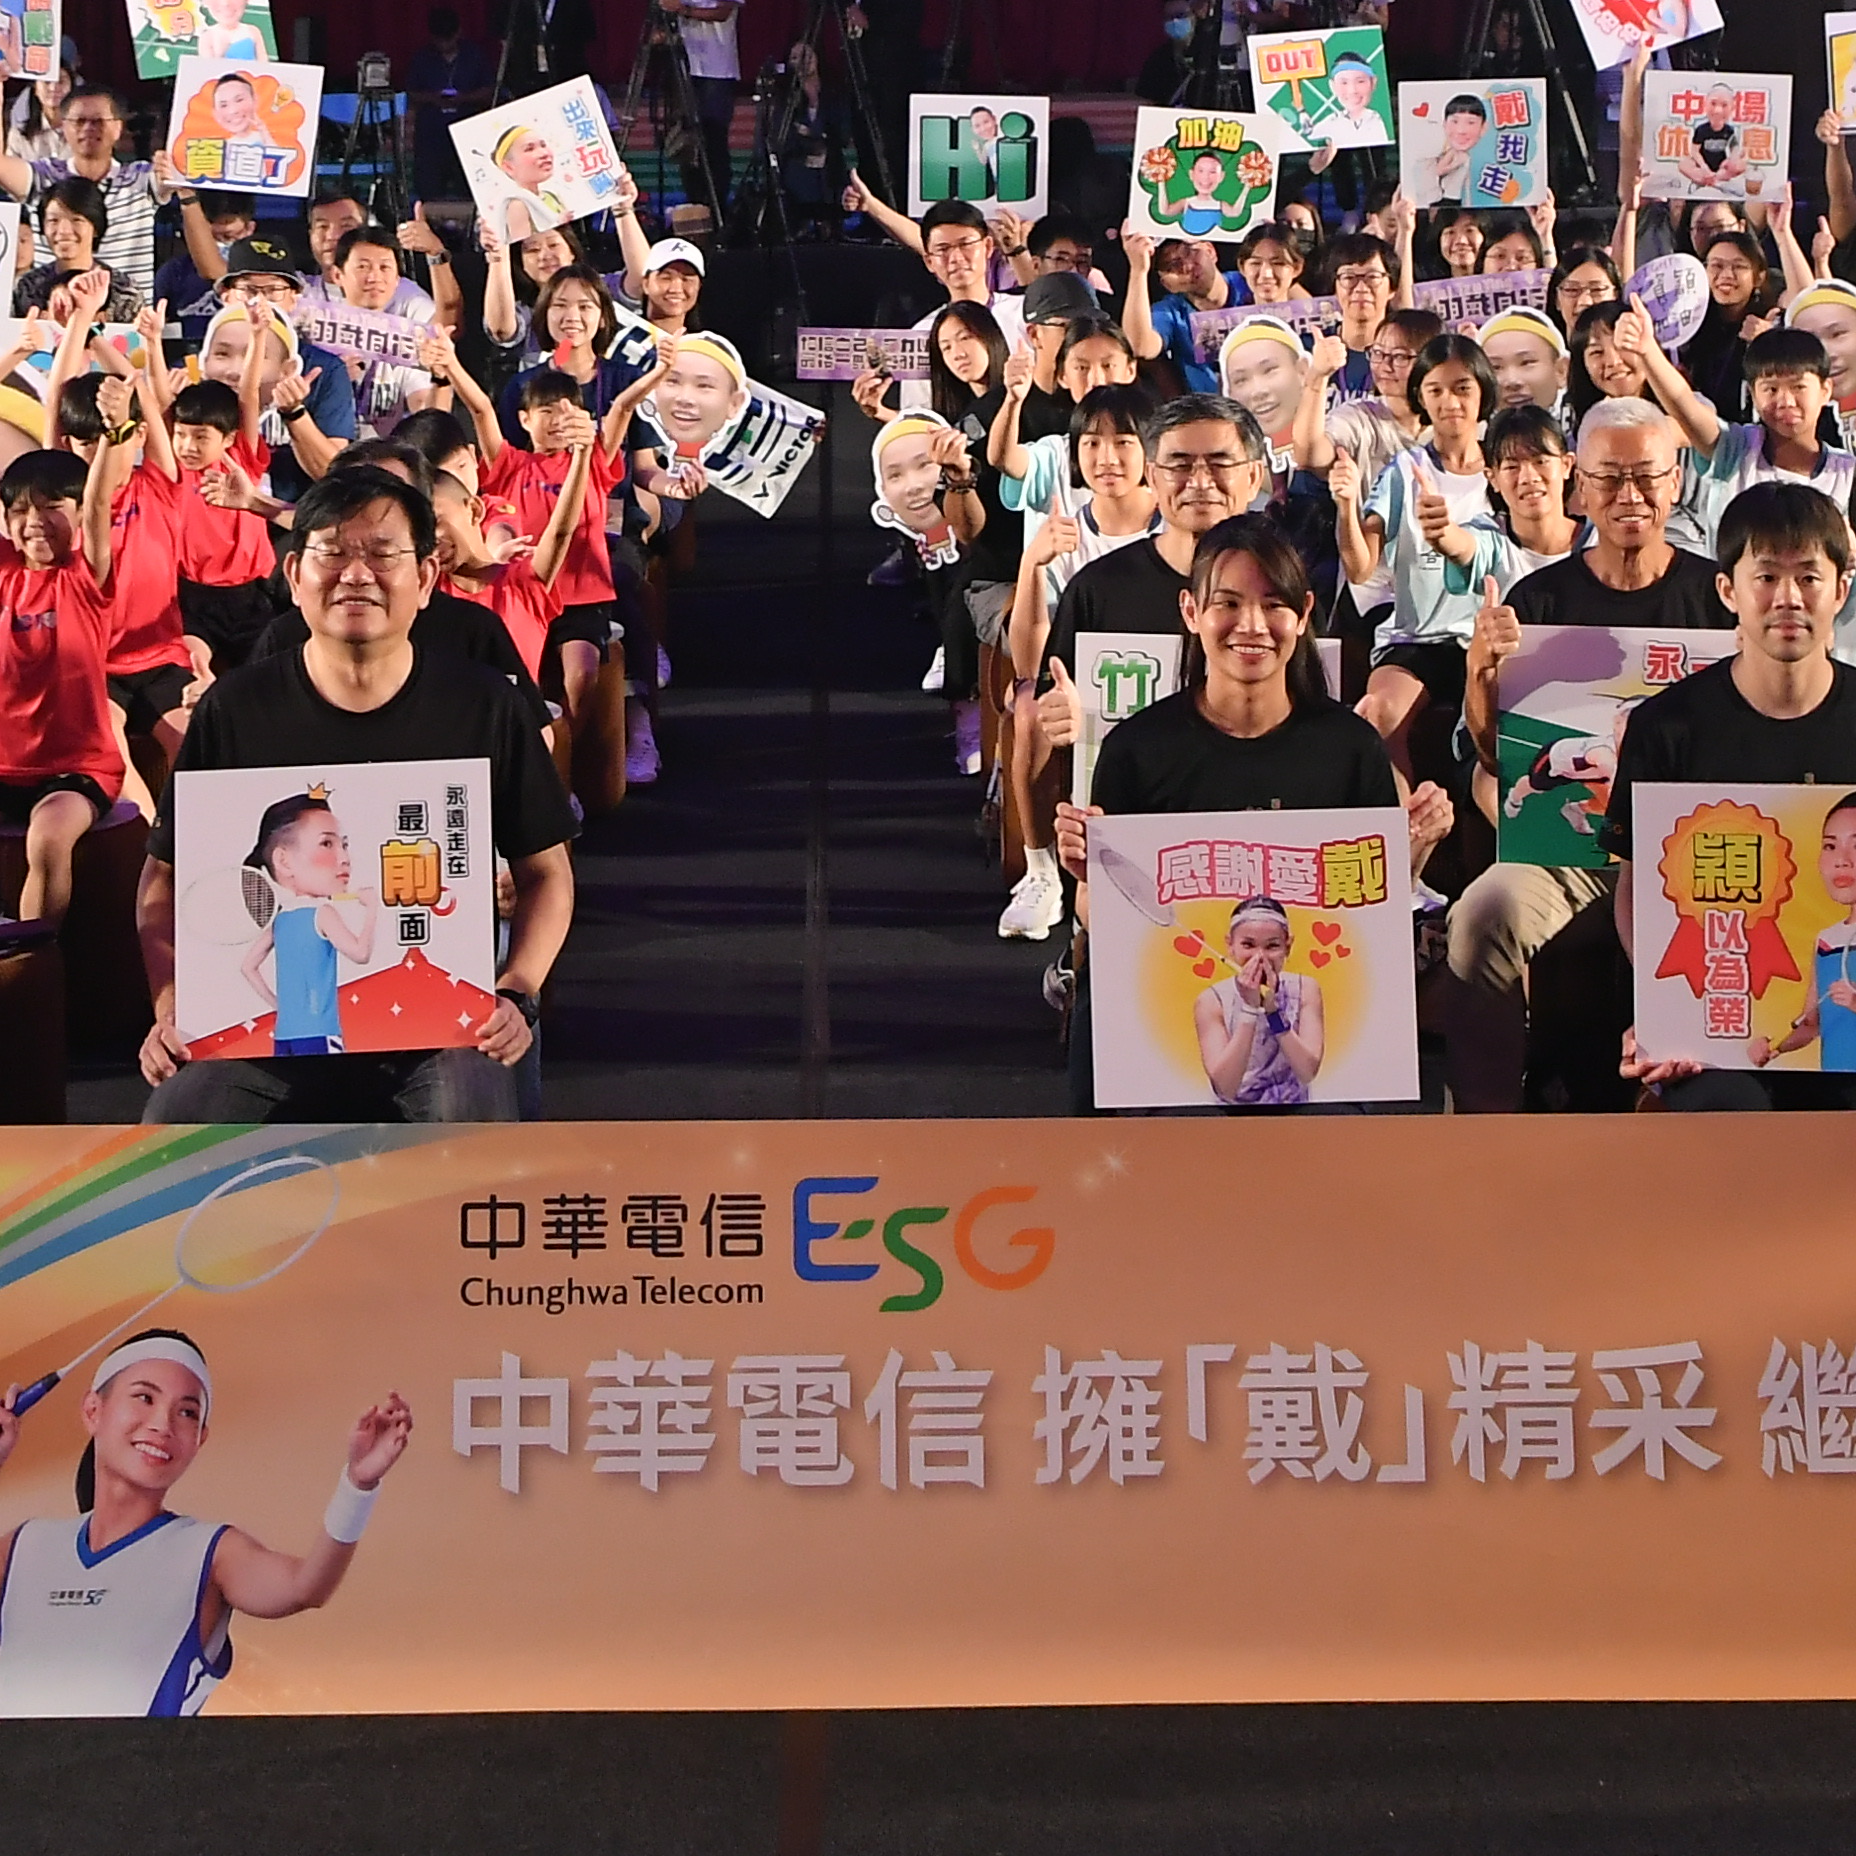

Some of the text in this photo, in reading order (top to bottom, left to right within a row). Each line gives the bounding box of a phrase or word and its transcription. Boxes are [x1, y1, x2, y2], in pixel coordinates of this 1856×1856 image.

[1265, 48, 1318, 74] OUT
[186, 137, 298, 186] 資道了
[919, 112, 1038, 202] Hi
[1178, 117, 1245, 153] 加油
[1478, 89, 1529, 199] 戴我走
[773, 415, 819, 479] VICTOR
[446, 785, 468, 877] 永遠走在
[380, 803, 441, 944] 最前面
[1159, 837, 1386, 906] 感謝愛戴
[460, 1176, 1056, 1312] 中華電信 ESG
[460, 1276, 764, 1313] Chunghwa Telecom
[453, 1346, 994, 1495] 中華電信
[1031, 1339, 1723, 1486] 擁「戴」精采
